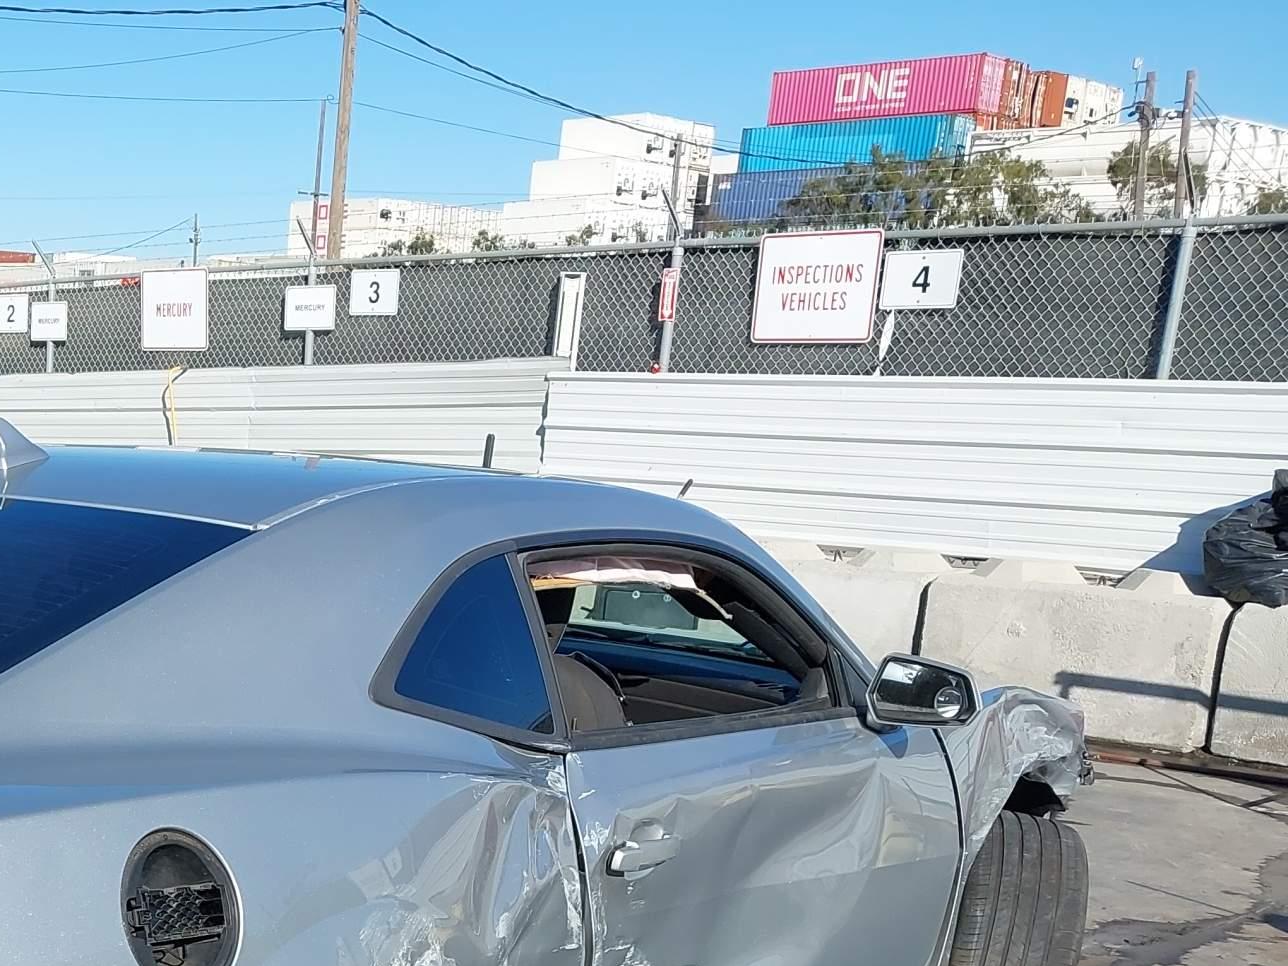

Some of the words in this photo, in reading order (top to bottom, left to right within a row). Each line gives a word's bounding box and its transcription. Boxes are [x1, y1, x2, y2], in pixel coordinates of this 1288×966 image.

[834, 67, 910, 103] ONE
[772, 263, 864, 286] INSPECTIONS
[912, 265, 931, 294] 4
[368, 281, 380, 304] 3
[781, 291, 847, 312] VEHICLES
[7, 304, 15, 323] 2
[155, 302, 193, 318] MERCURY
[295, 303, 326, 312] MERCURY
